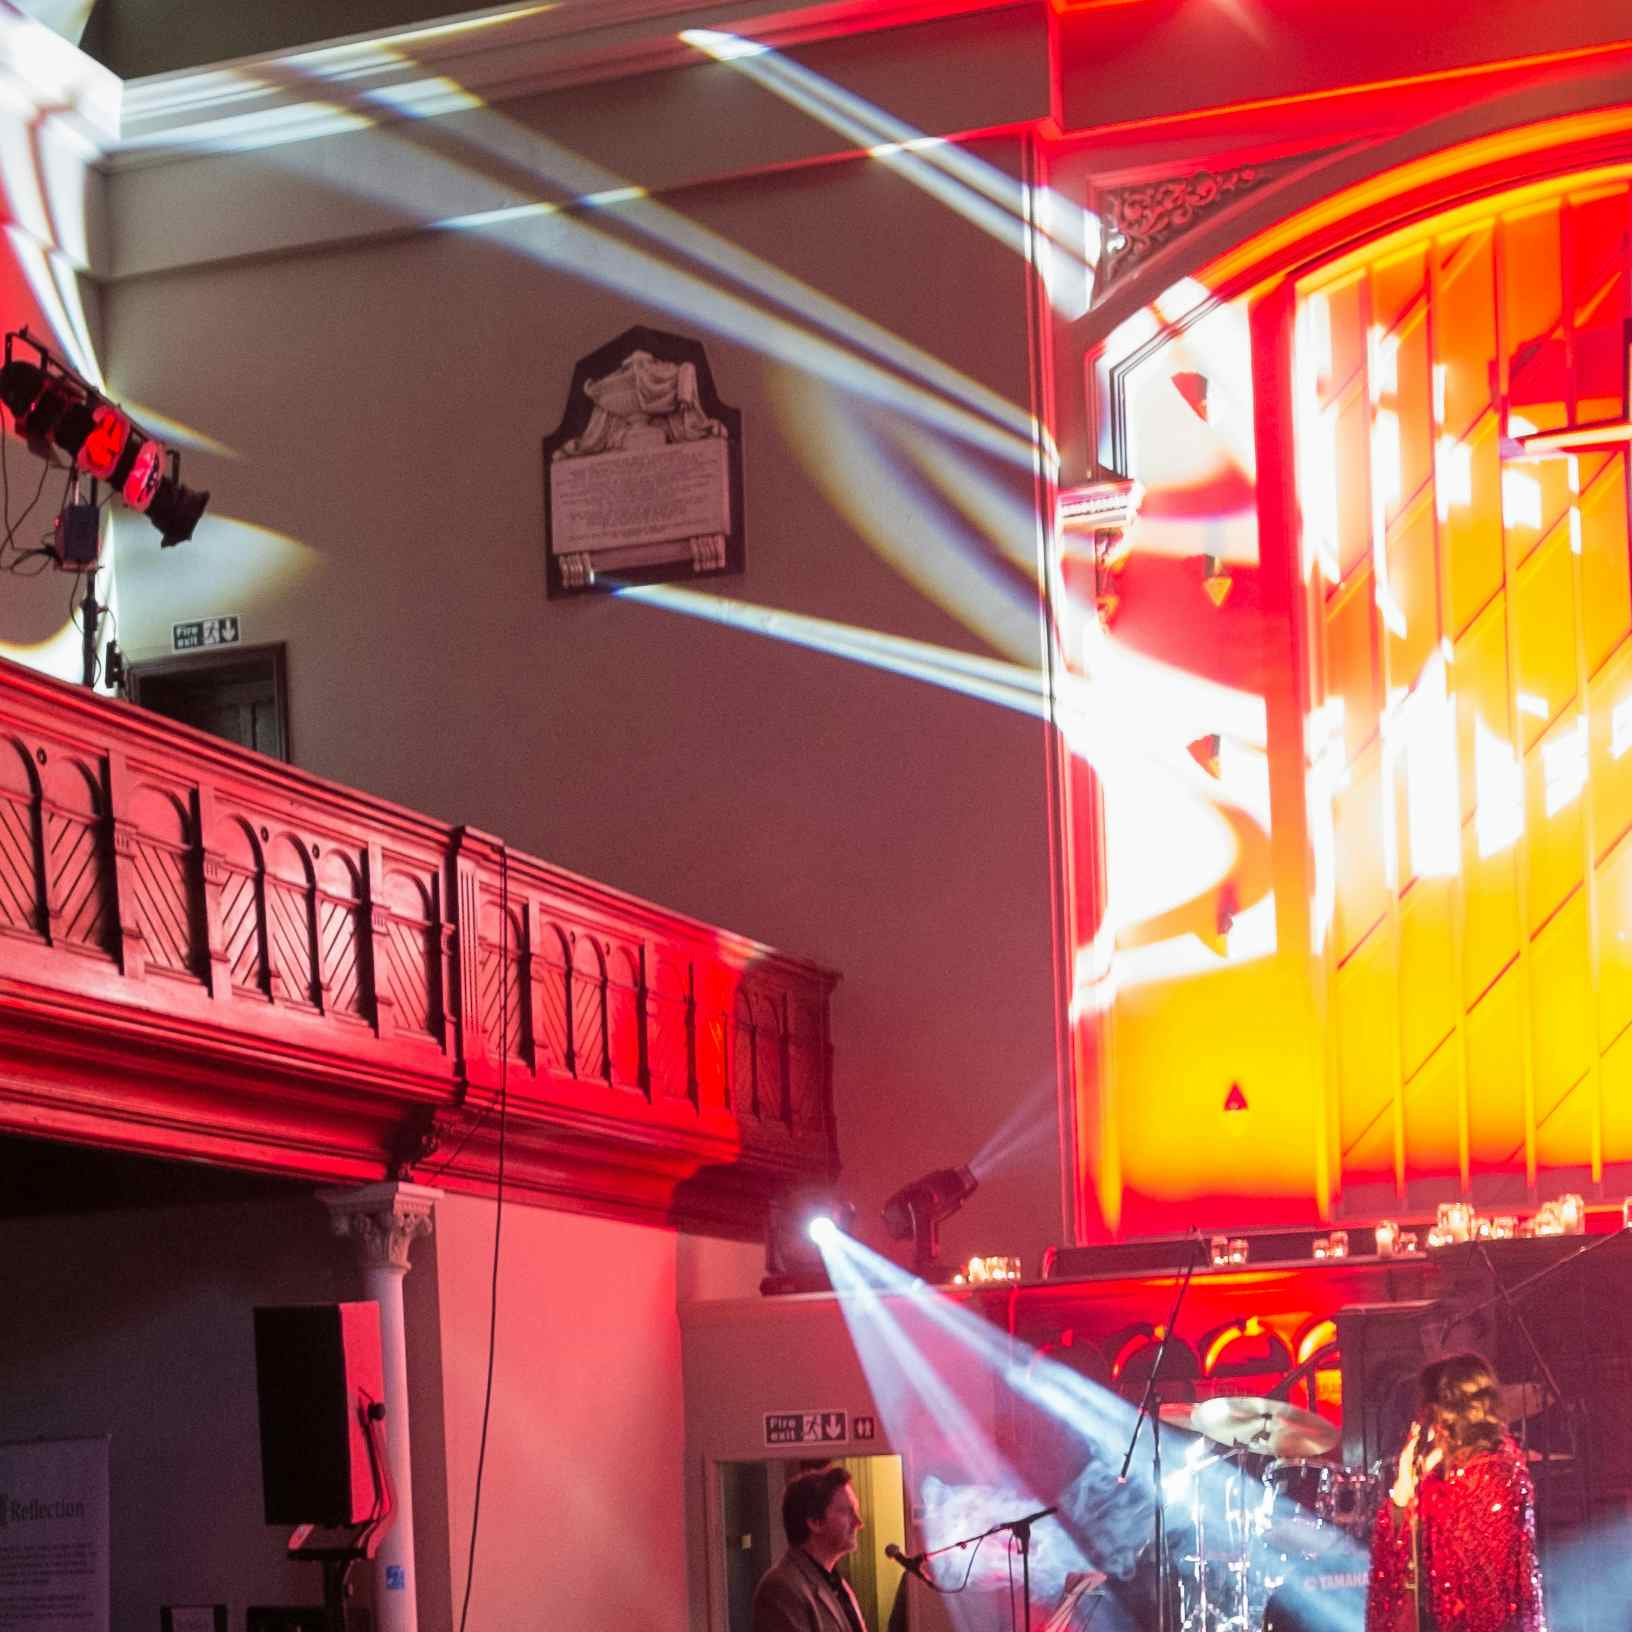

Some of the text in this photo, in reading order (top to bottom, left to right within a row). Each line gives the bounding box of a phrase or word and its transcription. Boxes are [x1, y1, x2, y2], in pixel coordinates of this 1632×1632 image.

[176, 626, 199, 638] Fire
[770, 1418, 796, 1429] Fire
[770, 1430, 795, 1441] exit
[10, 1498, 85, 1521] Reflection
